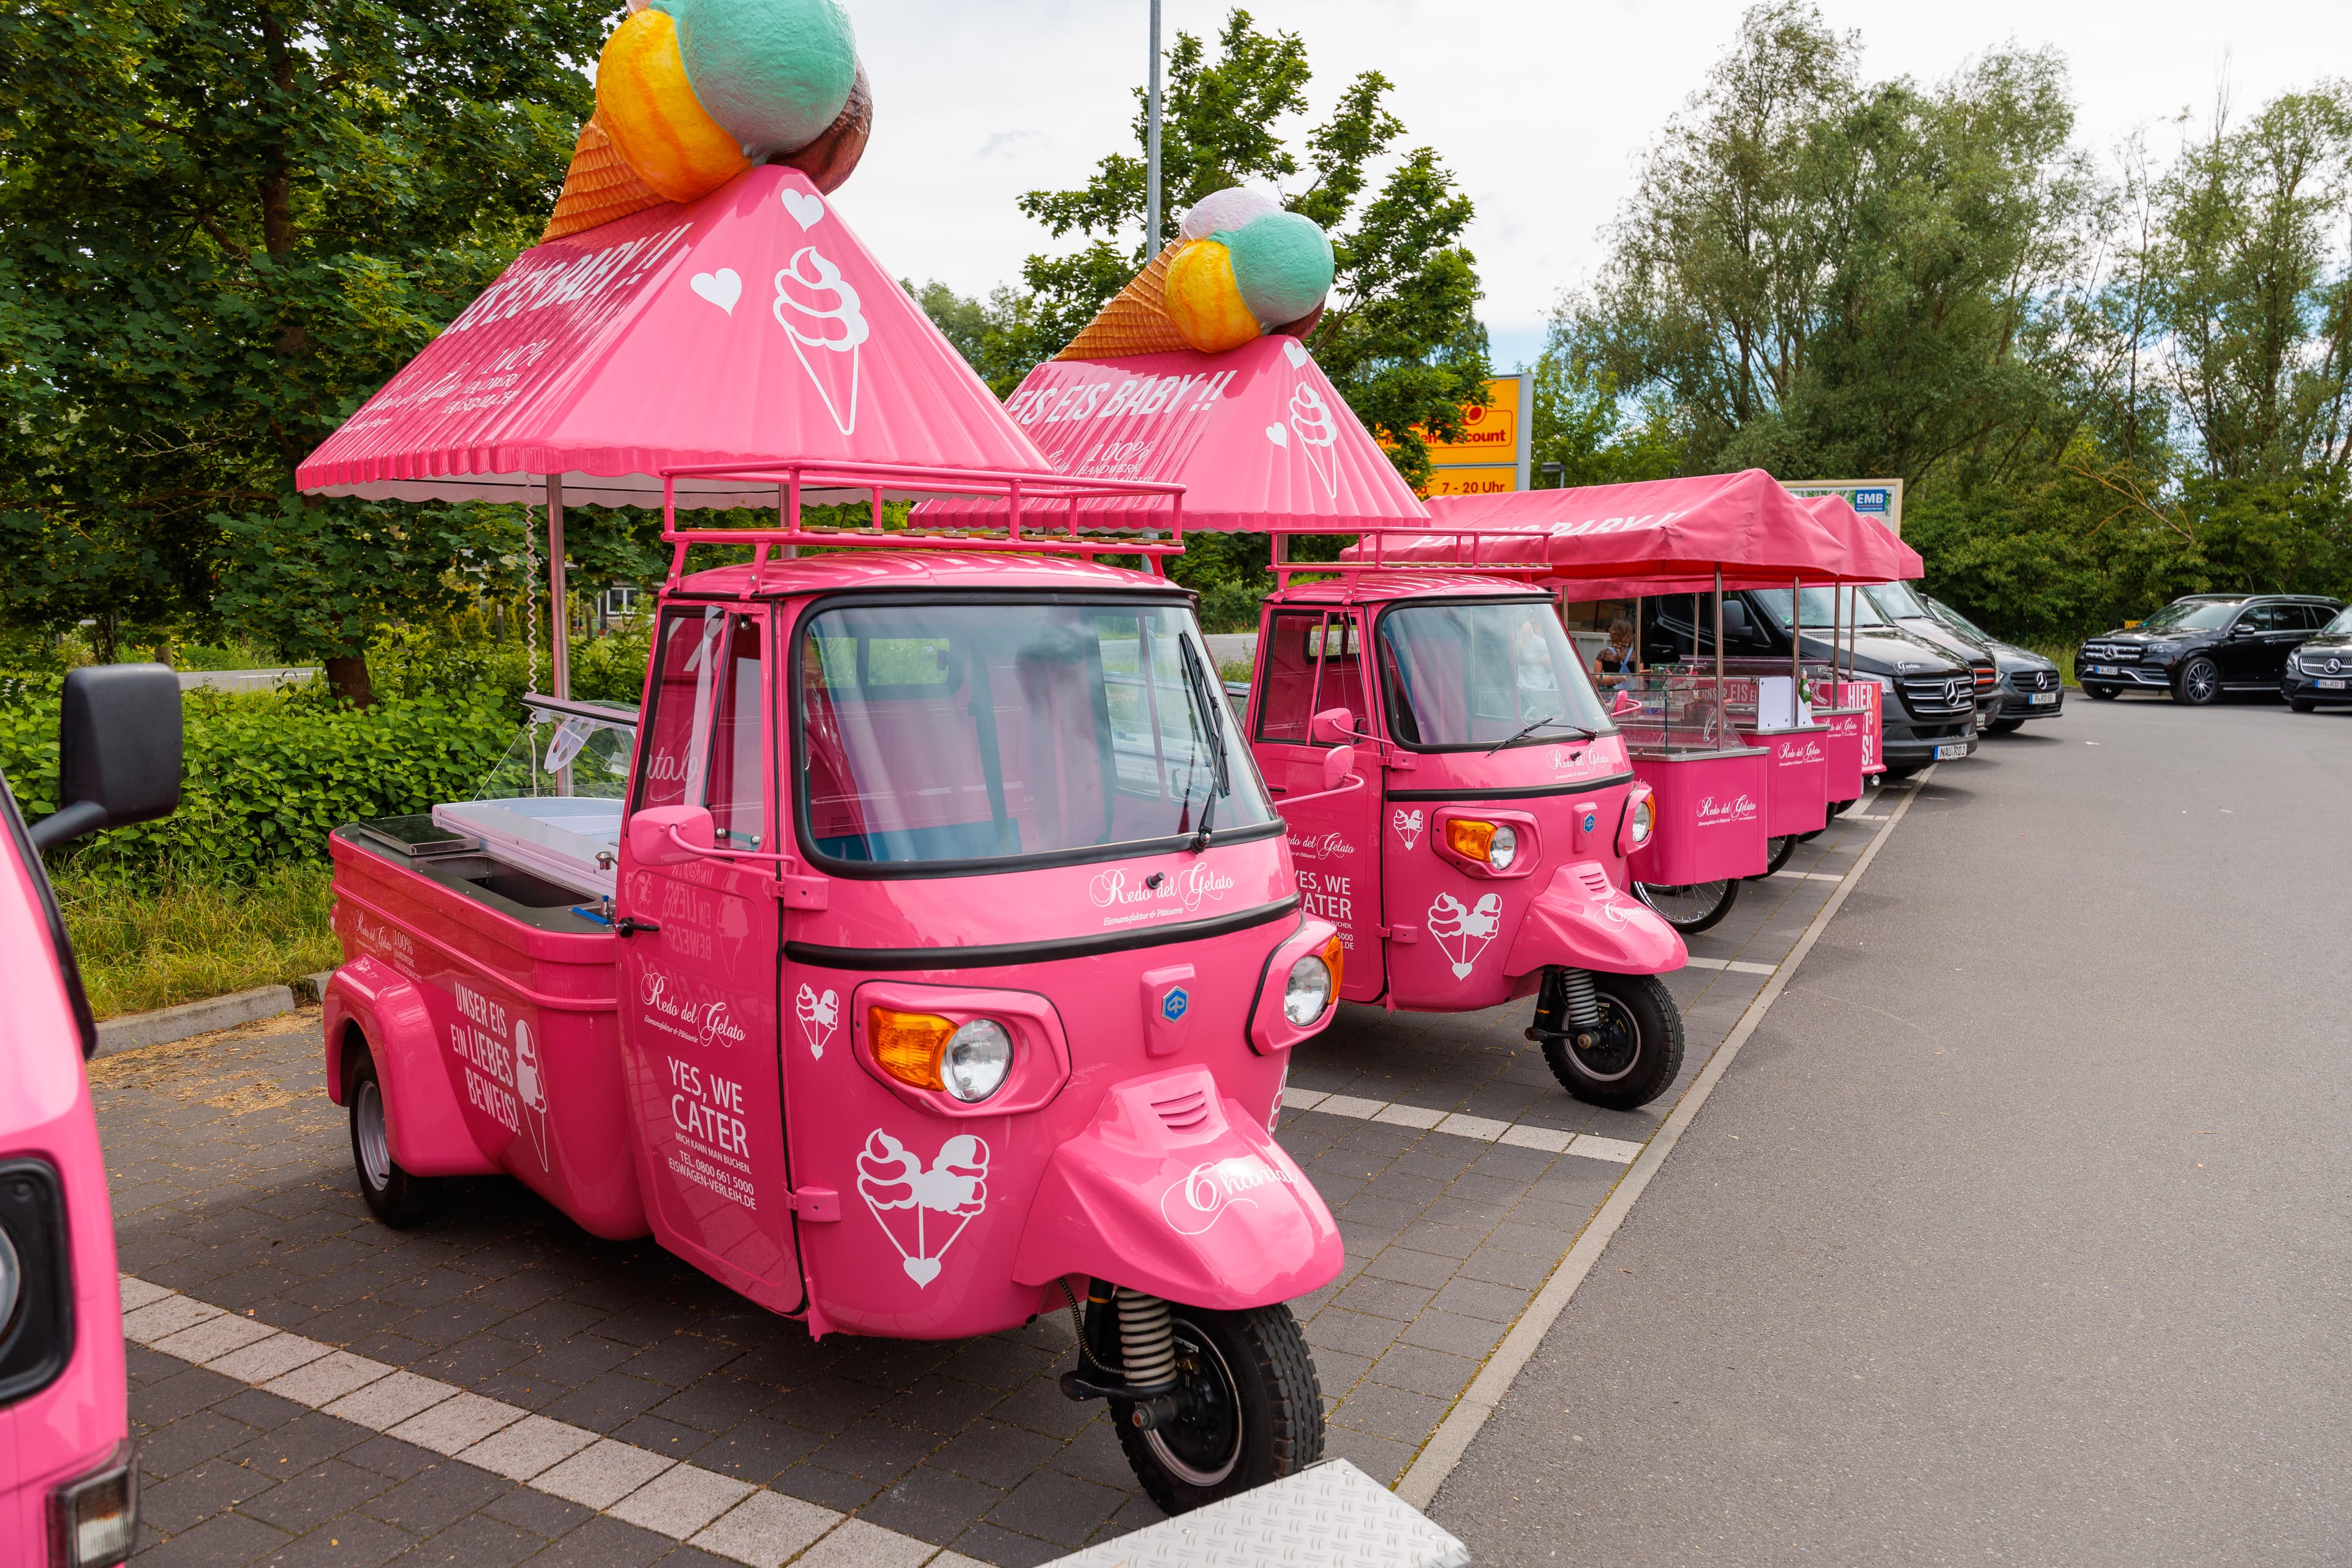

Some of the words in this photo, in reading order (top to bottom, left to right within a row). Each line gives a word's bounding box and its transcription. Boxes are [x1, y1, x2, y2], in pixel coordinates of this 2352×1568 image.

[1046, 382, 1110, 423] EIS
[1096, 372, 1207, 419] BABY
[1189, 369, 1238, 412] !!
[1087, 440, 1154, 462] 100%
[1442, 483, 1450, 493] 7
[1463, 481, 1479, 493] 20
[1482, 481, 1506, 492] Uhr
[1856, 493, 1884, 504] EMB
[1730, 684, 1748, 702] EIS
[1847, 685, 1873, 709] HIER
[1546, 748, 1574, 770] Redo
[1583, 747, 1610, 774] Gelato
[1803, 741, 1821, 764] Gelato
[1940, 746, 1952, 757] NAU
[1696, 796, 1721, 818] Redo
[1721, 801, 1731, 814] del
[1730, 794, 1757, 821] Gelato
[1302, 835, 1317, 848] del
[1316, 832, 1356, 861] Gelato
[1089, 867, 1153, 907] Redo
[1156, 875, 1178, 899] del
[1178, 862, 1235, 911] Gelato
[1325, 874, 1351, 895] WE
[1103, 911, 1149, 926] Eismanufaktur
[1156, 906, 1184, 918] Pâtisserie
[1299, 892, 1352, 921] ATER
[354, 909, 369, 938] Redo
[374, 926, 392, 956] Gelato
[394, 929, 413, 956] 100%
[1337, 932, 1354, 942] 5000
[454, 981, 489, 1028] UNSER
[489, 1000, 508, 1039] EIS
[641, 972, 679, 1016] Redo
[680, 1001, 698, 1024] del
[697, 1002, 746, 1048] Gelato
[644, 1014, 673, 1033] Eismanufaktur
[678, 1029, 699, 1044] Pâtisserie
[450, 1023, 469, 1059] EIN
[467, 1024, 514, 1088] LIEBES
[667, 1055, 707, 1104] YES,
[709, 1074, 745, 1115] WE
[464, 1066, 522, 1137] BEWEIS!
[671, 1093, 750, 1159] CATER
[675, 1131, 690, 1147] MICH
[690, 1138, 707, 1155] KANN
[707, 1147, 723, 1162] MAN
[723, 1154, 752, 1175] BUCHEN.
[668, 1156, 756, 1211] EISWAGEN-VERLEIH.DE
[679, 1150, 696, 1168] TEL.
[695, 1158, 715, 1178] 0800
[716, 1169, 731, 1186] 661
[733, 1176, 755, 1196] 5000
